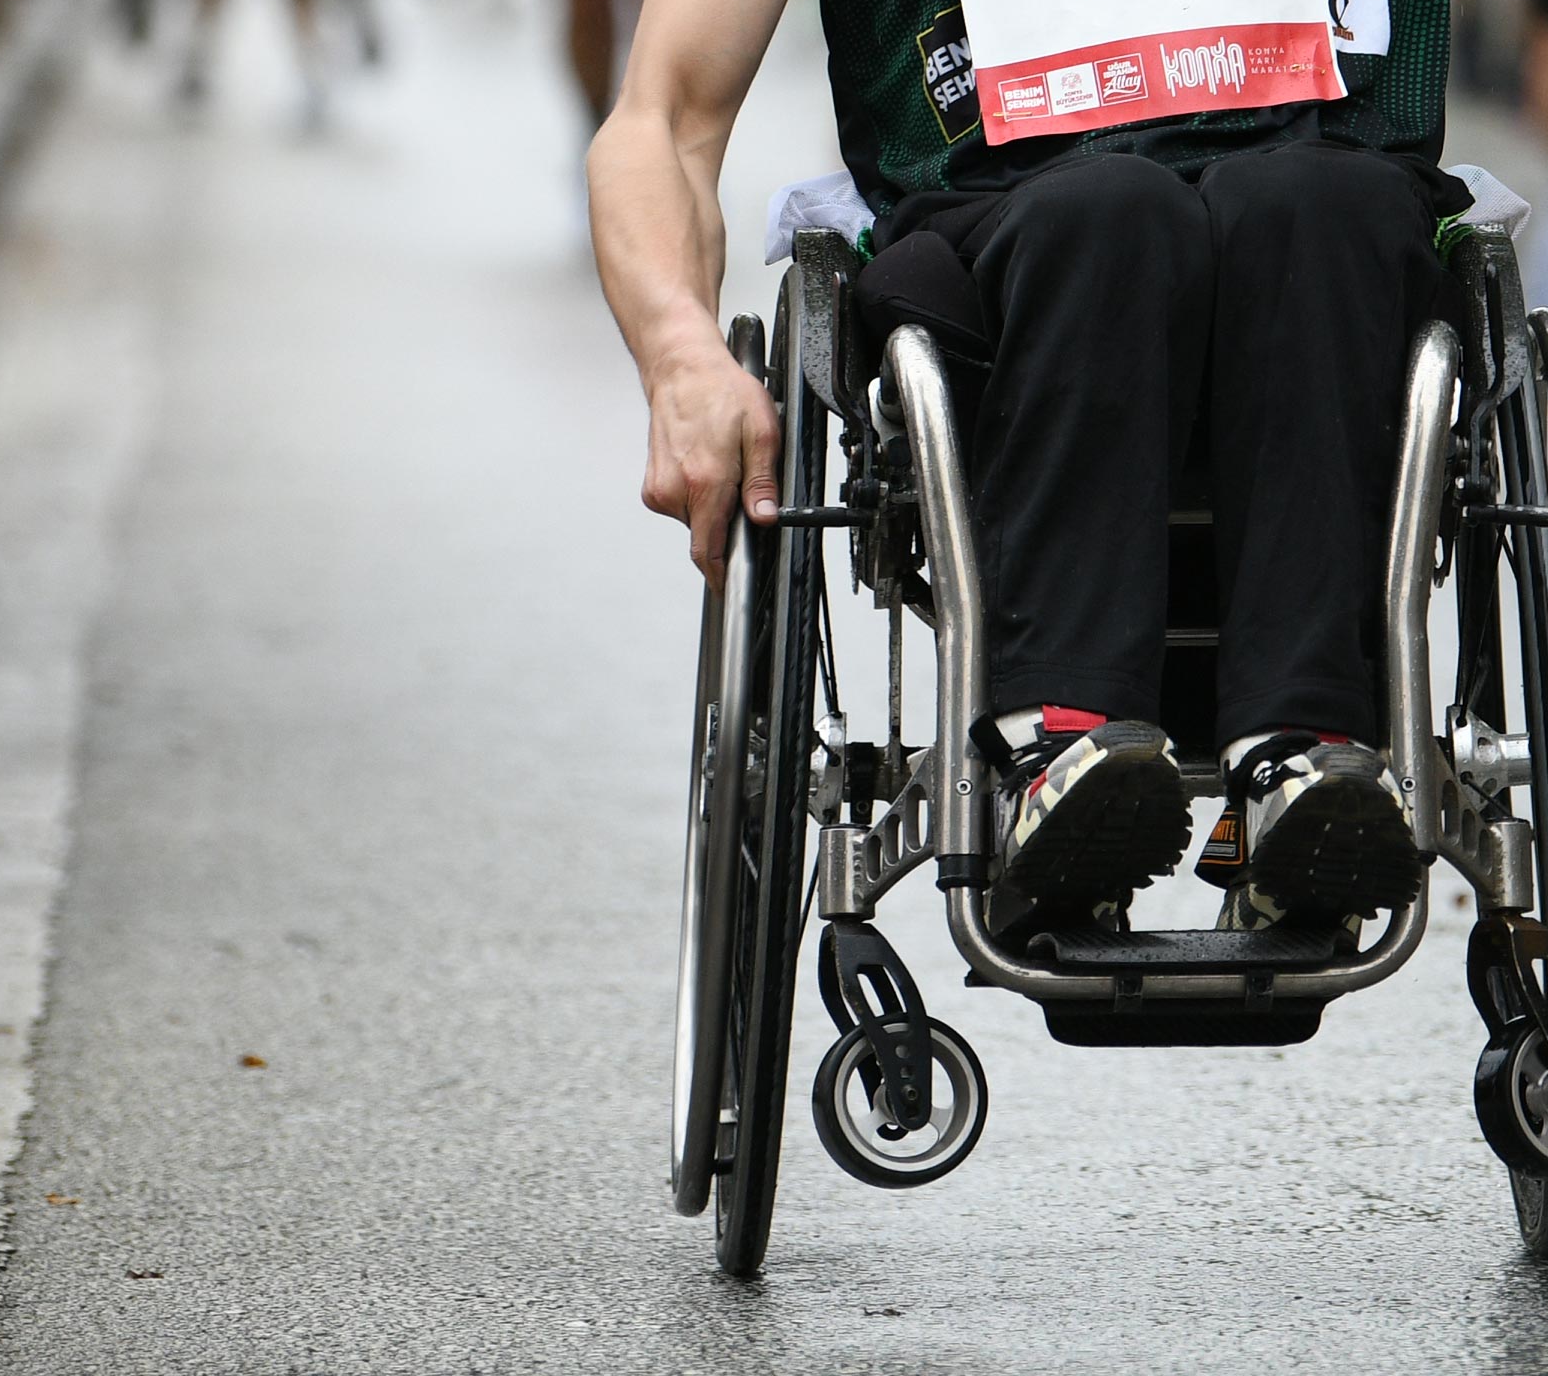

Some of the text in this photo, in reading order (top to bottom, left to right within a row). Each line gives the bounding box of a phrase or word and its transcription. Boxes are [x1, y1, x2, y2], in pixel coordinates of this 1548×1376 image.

[925, 36, 973, 85] BEN
[1248, 47, 1285, 56] KONYA
[1249, 57, 1275, 65] YARI
[1158, 36, 1247, 98] KONYA
[1102, 74, 1142, 99] Altay
